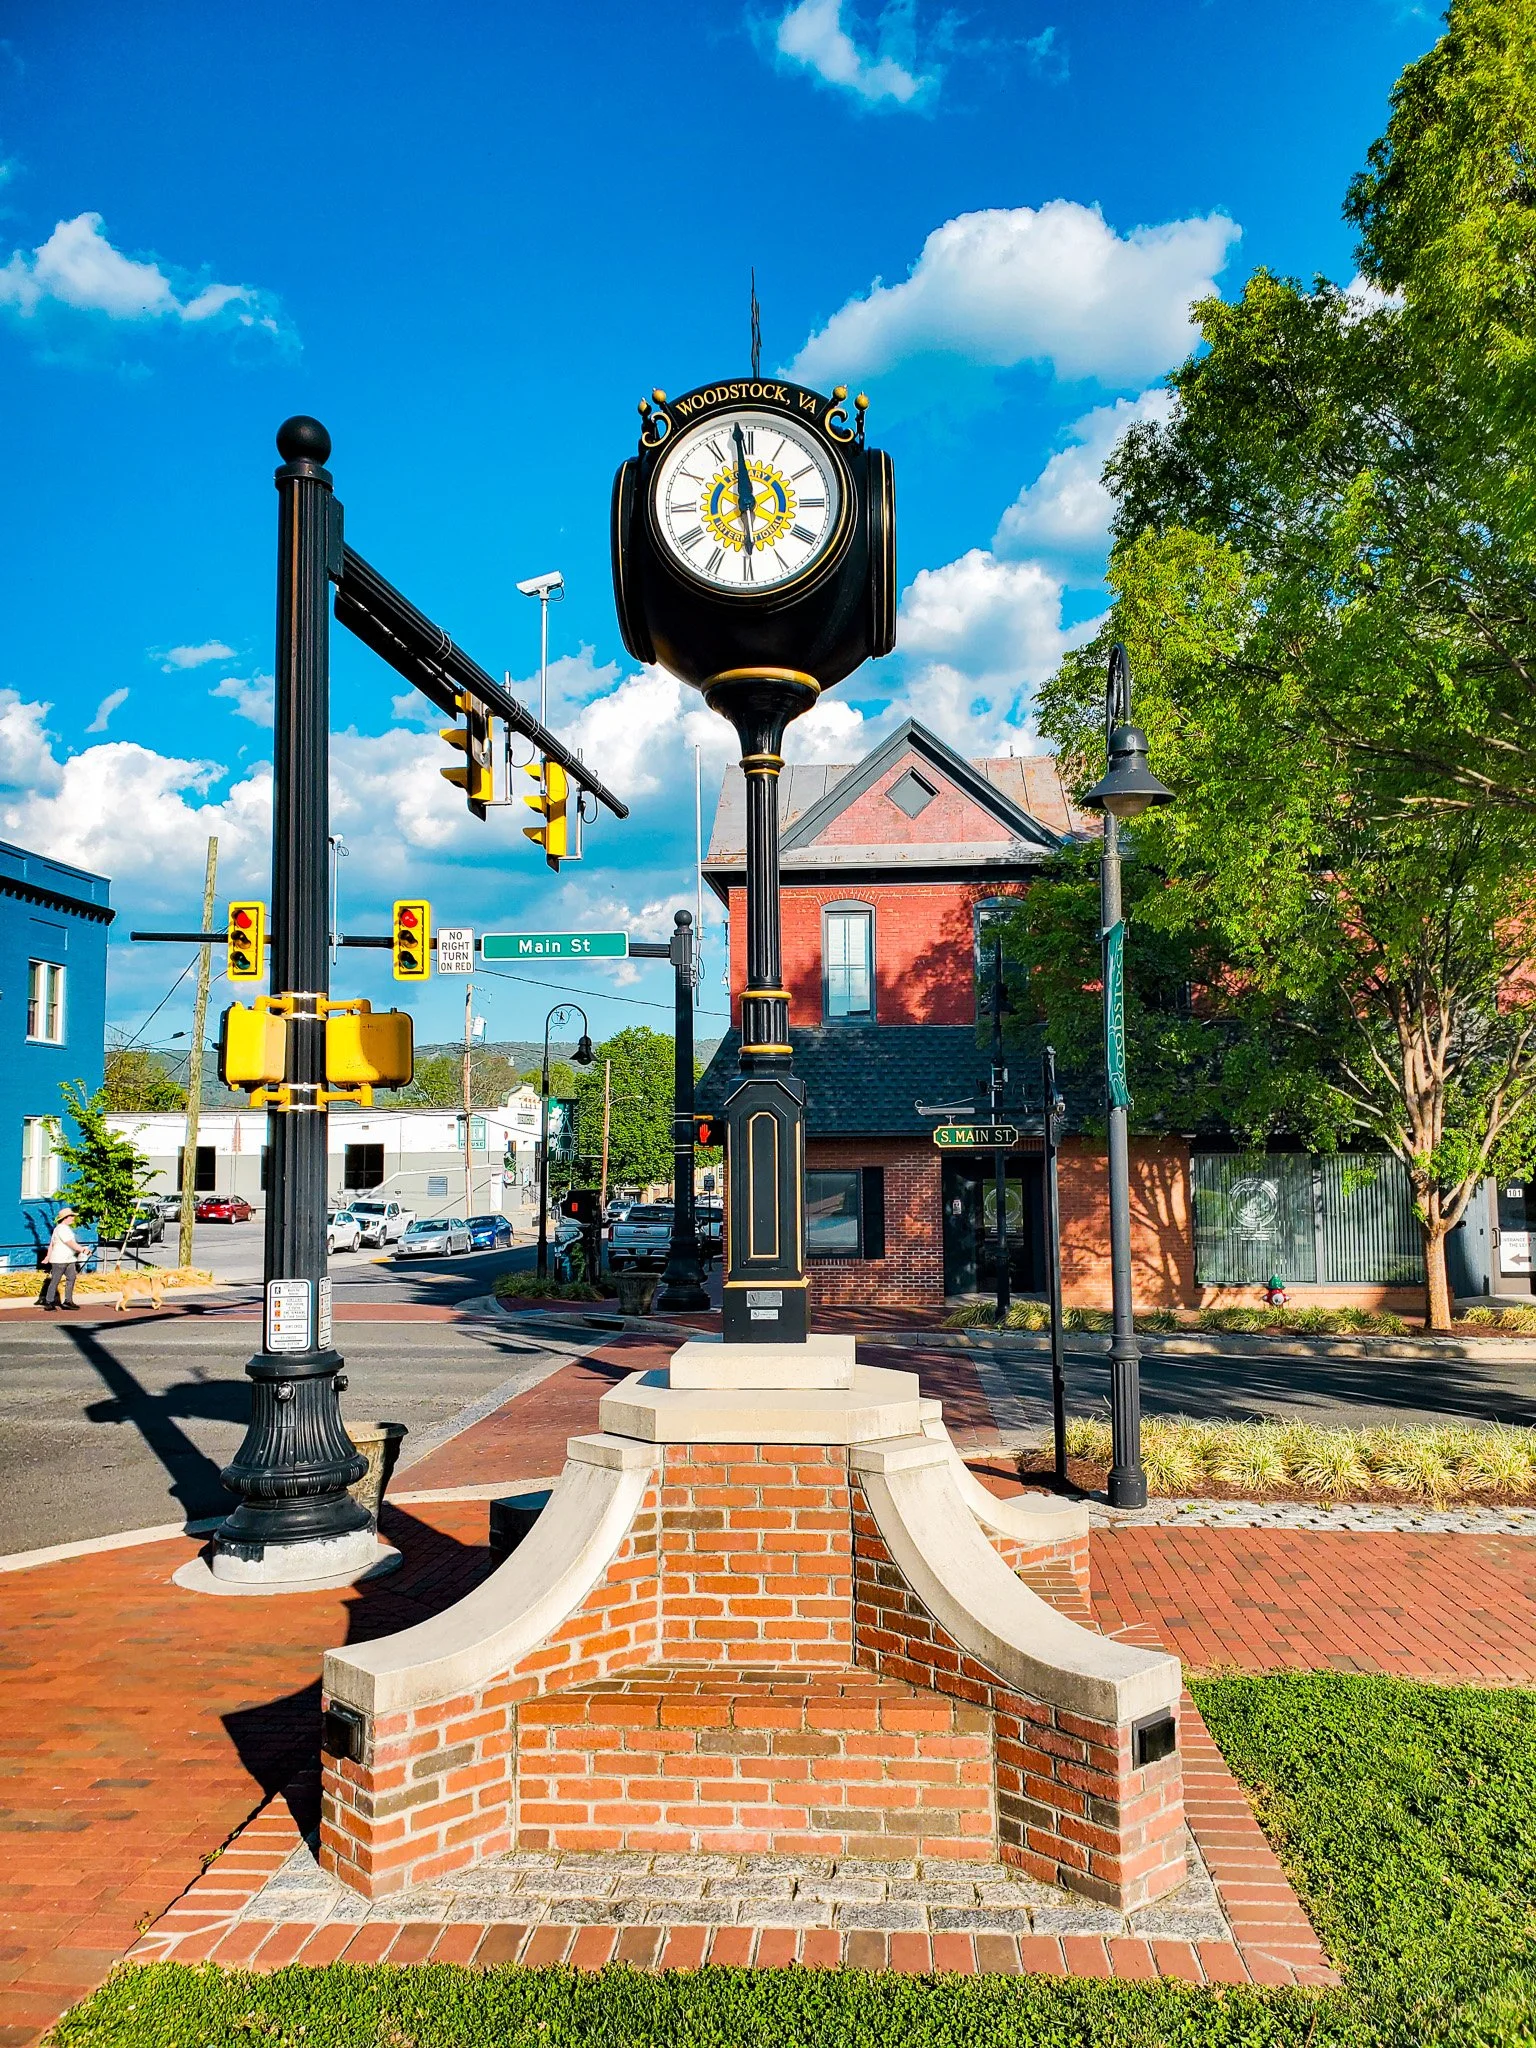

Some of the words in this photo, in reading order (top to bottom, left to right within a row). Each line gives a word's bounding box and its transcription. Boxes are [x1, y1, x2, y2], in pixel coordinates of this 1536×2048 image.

[676, 383, 791, 416] WOODSTOCK,
[799, 392, 817, 415] VA
[716, 518, 783, 542] INTERNTIONAL
[449, 931, 463, 941] NO
[441, 941, 470, 951] RIGHT
[519, 939, 561, 954] Main
[571, 938, 591, 953] St
[443, 951, 469, 961] TURN
[440, 962, 453, 972] ON
[455, 961, 472, 971] RED
[940, 1130, 952, 1143] S.
[955, 1130, 989, 1143] MAIN
[994, 1129, 1012, 1142] ST.
[1508, 1189, 1522, 1197] 101
